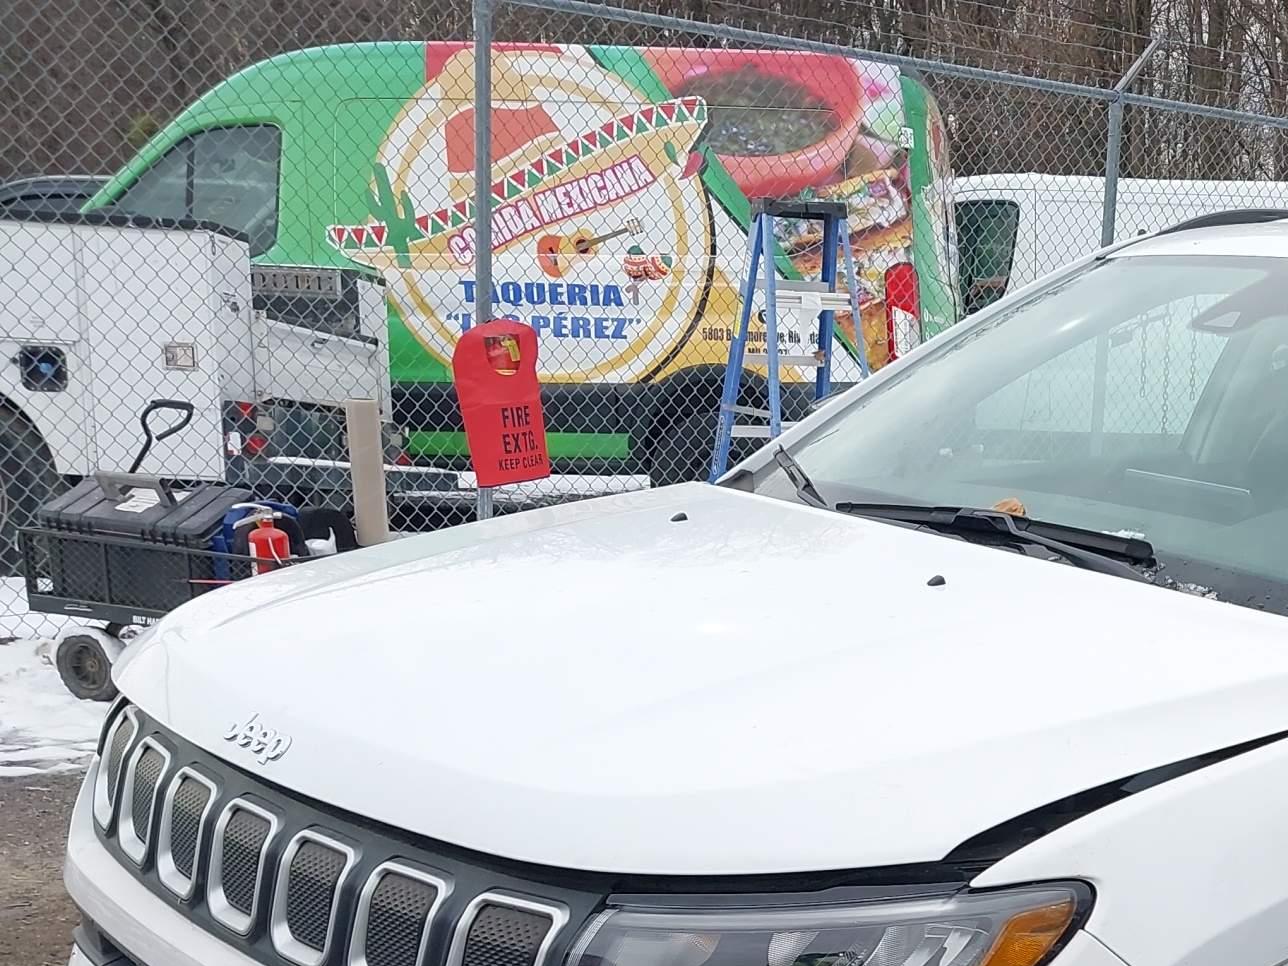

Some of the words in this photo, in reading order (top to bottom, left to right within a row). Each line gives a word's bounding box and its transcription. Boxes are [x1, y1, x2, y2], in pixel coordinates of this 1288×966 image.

[533, 154, 657, 225] MEXICANA
[702, 328, 724, 341] 5803
[501, 406, 531, 428] FIRE
[502, 431, 538, 455] EXTG.
[499, 458, 521, 471] KEEP
[522, 453, 544, 468] CLEAR
[223, 713, 292, 766] Jeep
